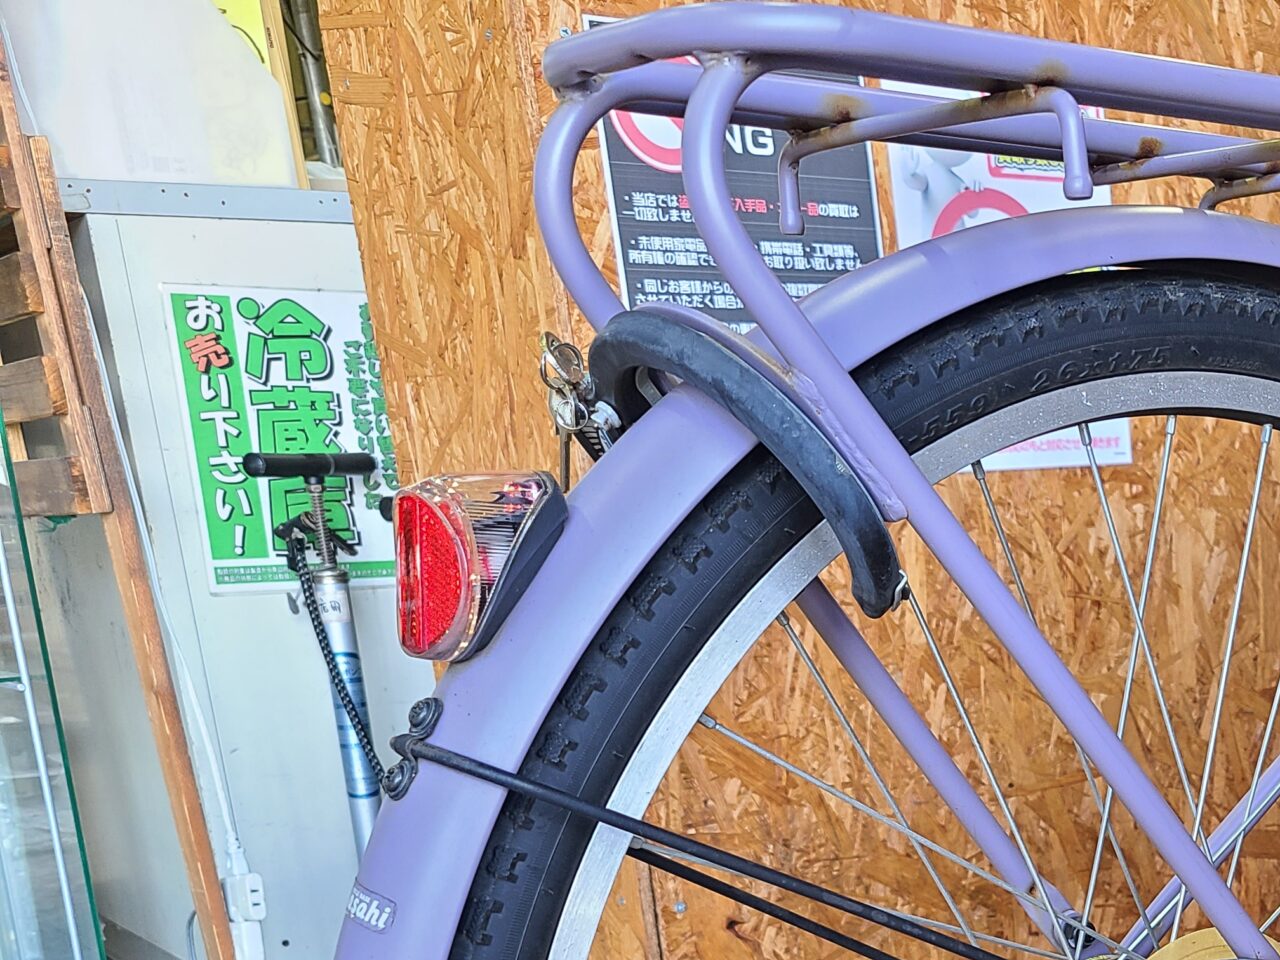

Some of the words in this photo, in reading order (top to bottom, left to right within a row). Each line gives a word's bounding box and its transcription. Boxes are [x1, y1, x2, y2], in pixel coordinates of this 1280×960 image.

[622, 207, 696, 222] 一切致しませ
